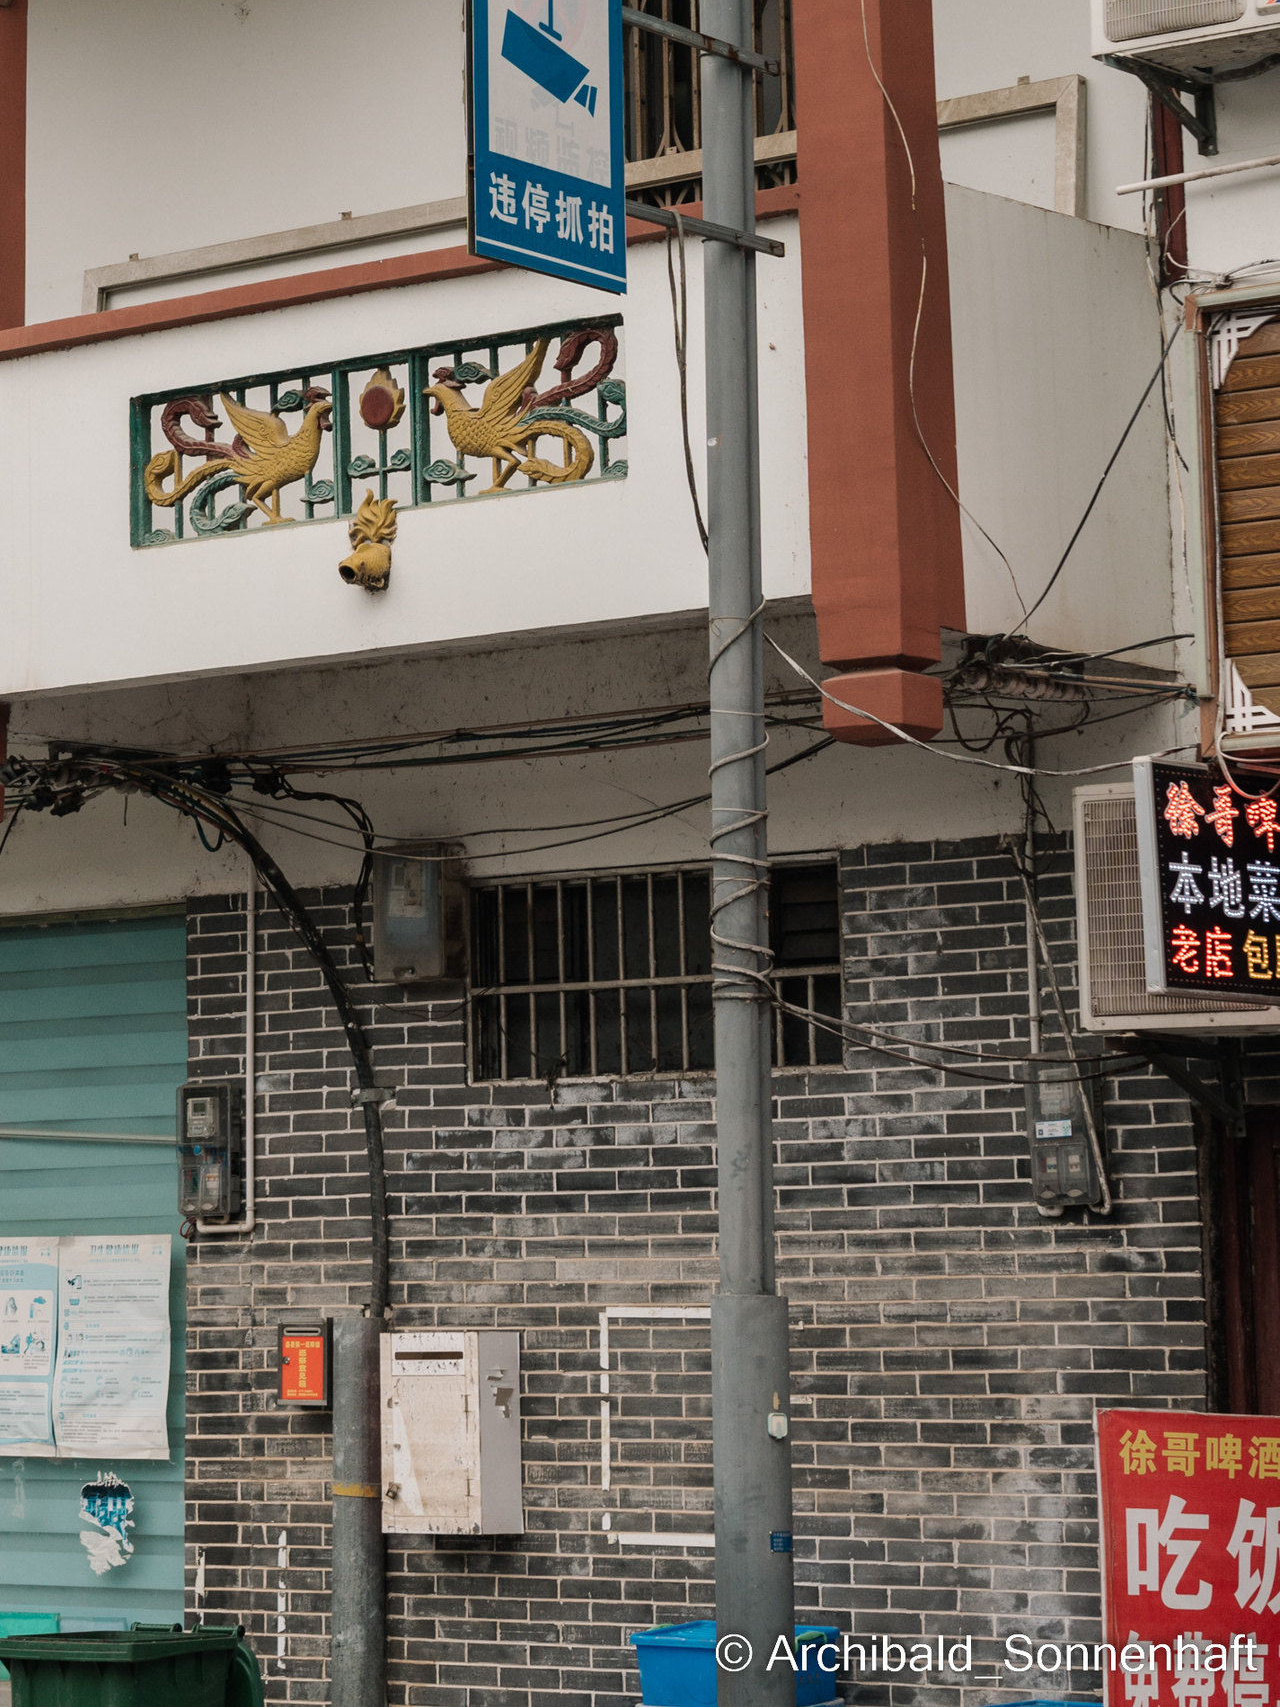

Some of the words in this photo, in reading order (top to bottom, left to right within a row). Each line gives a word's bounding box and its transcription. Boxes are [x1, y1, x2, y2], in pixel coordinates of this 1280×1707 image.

[489, 172, 614, 254] 违停抓拍
[1168, 851, 1280, 922] 本地菜
[1171, 923, 1234, 978] 老店
[1119, 1429, 1280, 1480] 徐哥啤酒
[1125, 1494, 1280, 1615] 吃饭
[1119, 1630, 1280, 1707] 免费停
